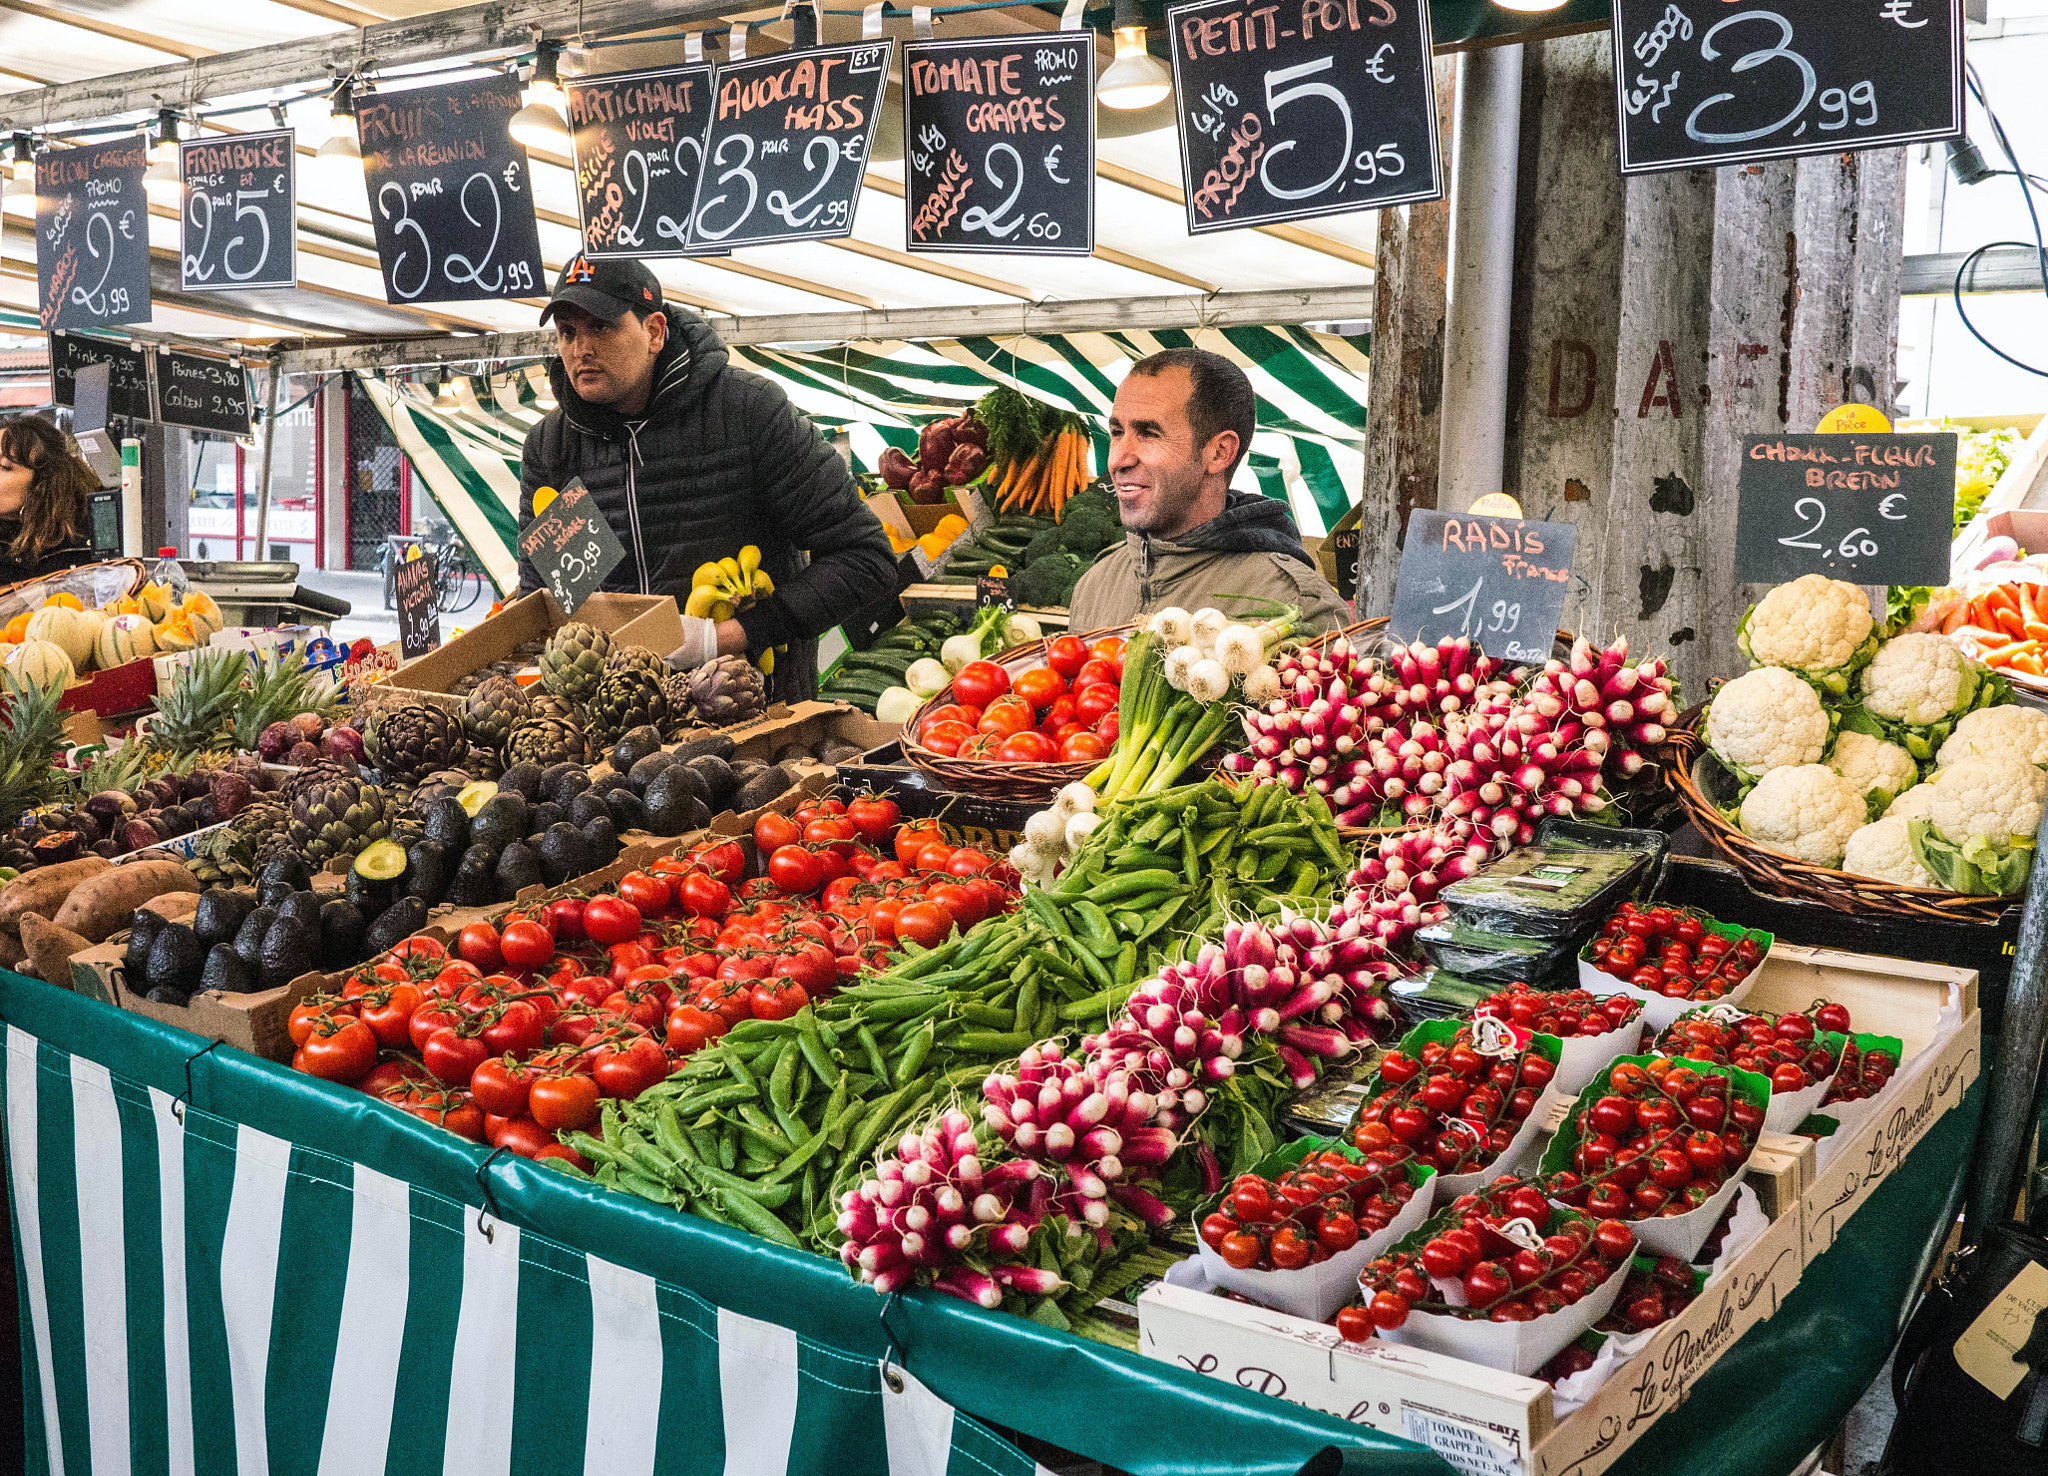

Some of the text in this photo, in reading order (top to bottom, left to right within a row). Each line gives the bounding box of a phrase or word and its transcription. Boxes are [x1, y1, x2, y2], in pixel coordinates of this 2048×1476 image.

[719, 59, 846, 121] AVOCAT
[910, 54, 1023, 96] TOMATE
[1034, 48, 1078, 72] PROMO
[1366, 43, 1395, 84] €
[1685, 10, 1879, 144] 3,99
[784, 94, 864, 131] HASS
[966, 95, 1066, 134] GRAPPES
[1260, 55, 1406, 200] 5,95
[85, 178, 121, 197] PROMO
[273, 174, 285, 193] €
[695, 133, 758, 241] 3
[766, 135, 848, 228] 2,99
[840, 135, 864, 161] €
[912, 148, 969, 241] FRANCE
[960, 142, 1071, 241] 2,60 €
[1194, 112, 1262, 218] PROMO
[224, 189, 270, 280] 5
[378, 181, 431, 299] 3
[443, 172, 534, 294] 2,99
[503, 161, 521, 192] €
[586, 182, 624, 251] PROMO
[72, 210, 134, 317] 2,99 €
[68, 343, 98, 364] Pink
[1777, 493, 1907, 559] 2,60 €
[1432, 575, 1521, 638] 1,99
